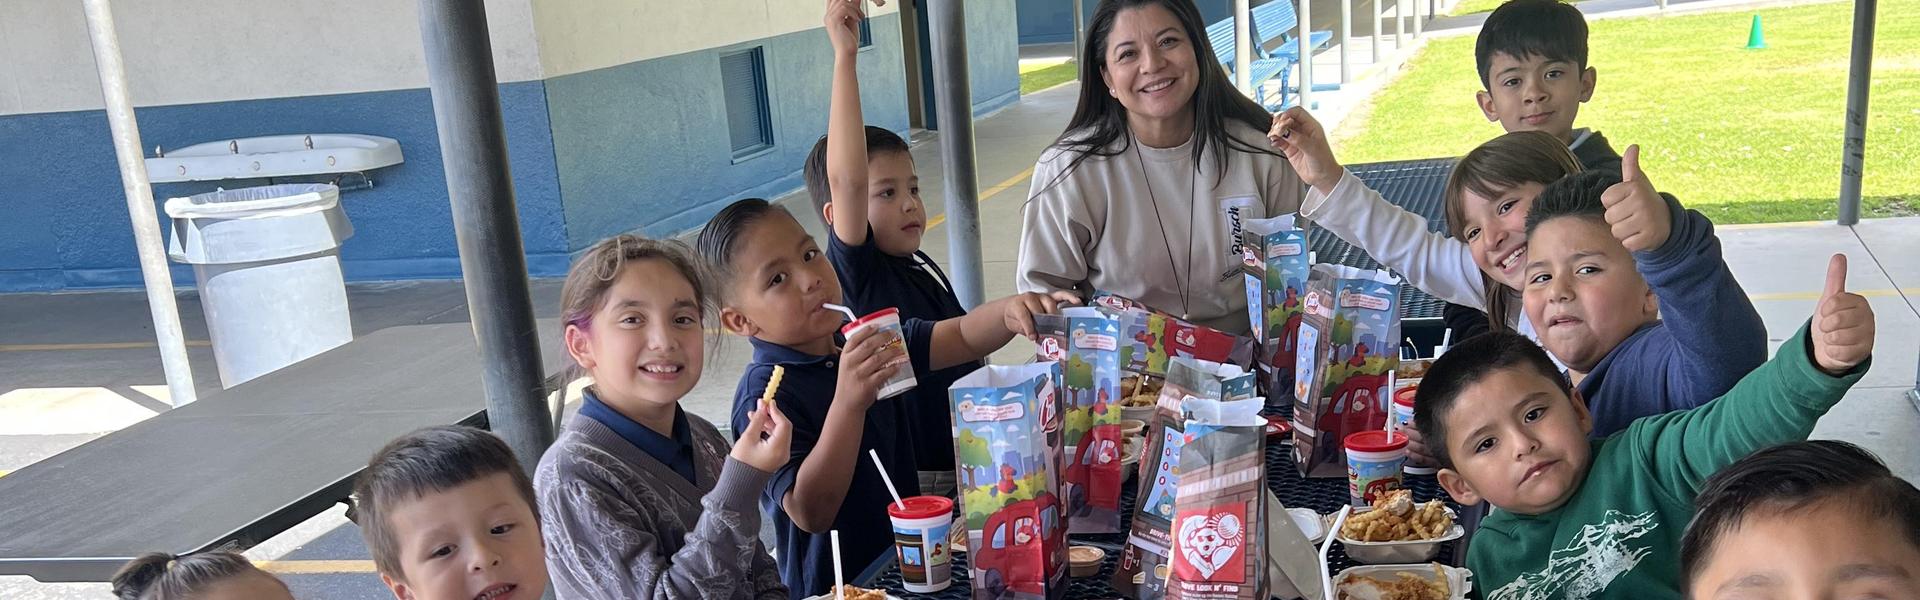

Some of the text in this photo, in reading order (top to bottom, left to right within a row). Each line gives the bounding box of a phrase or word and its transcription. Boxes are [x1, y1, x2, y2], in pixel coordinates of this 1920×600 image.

[1228, 205, 1244, 255] Bursch
[1196, 584, 1212, 592] LOOK
[1223, 585, 1239, 593] FIND
